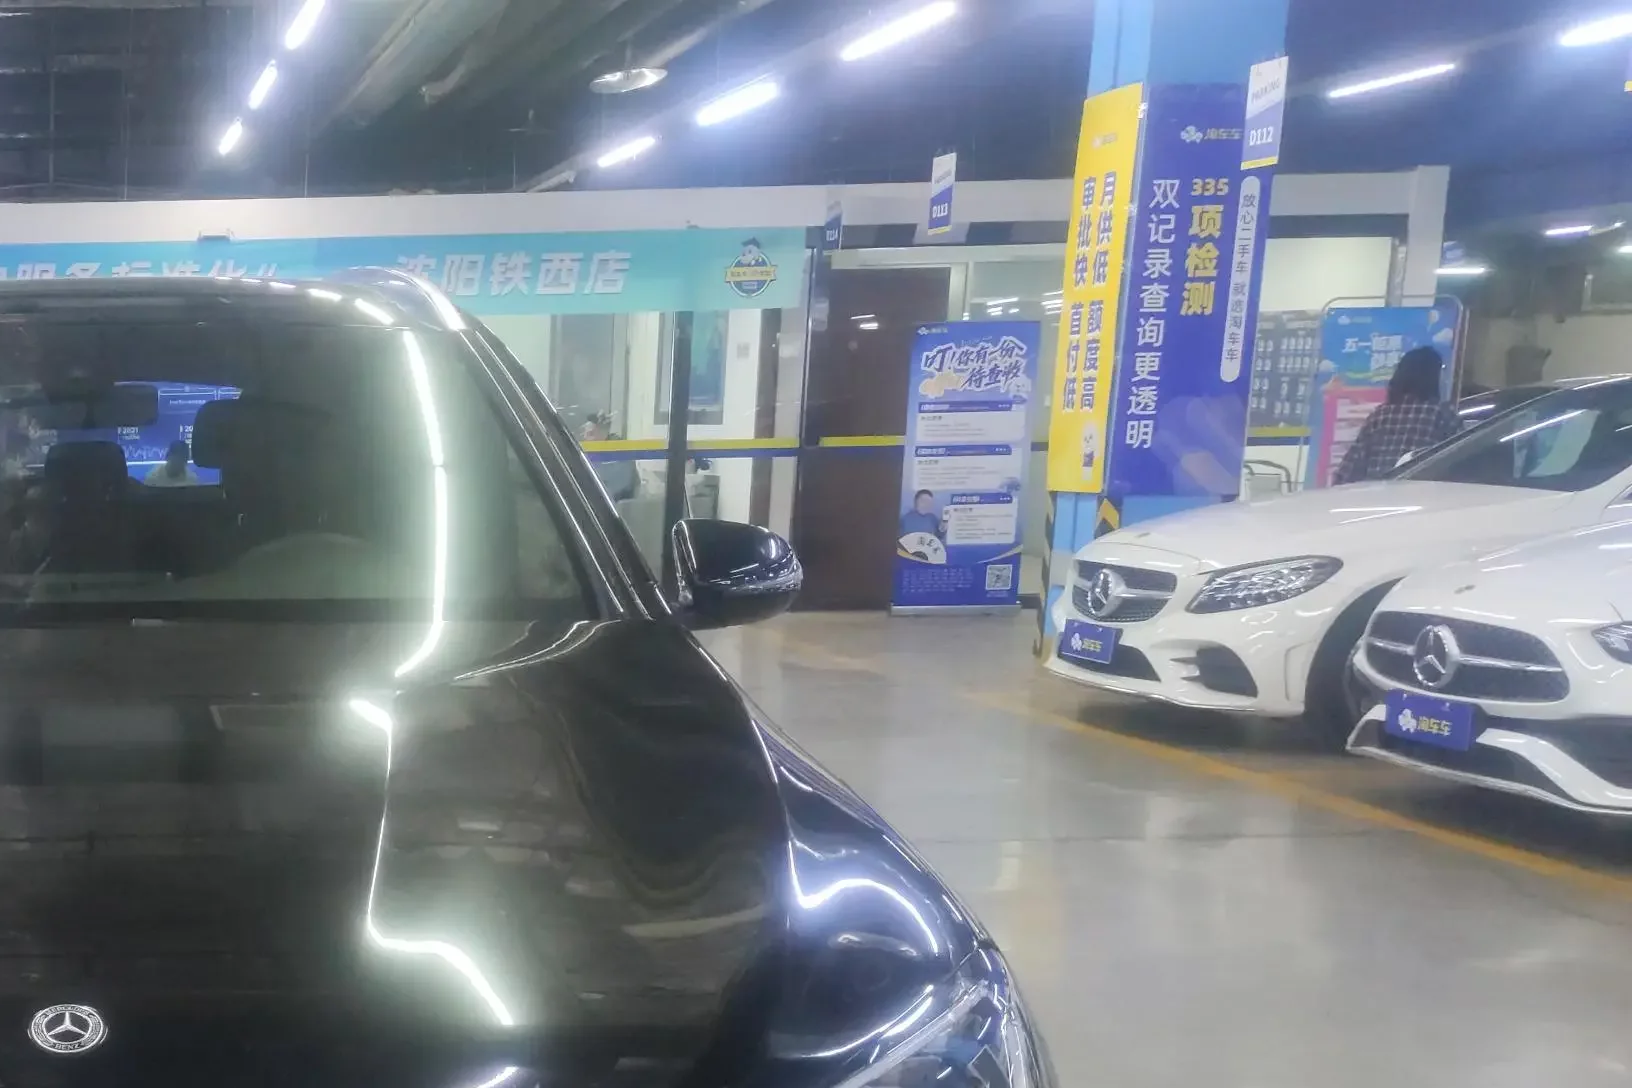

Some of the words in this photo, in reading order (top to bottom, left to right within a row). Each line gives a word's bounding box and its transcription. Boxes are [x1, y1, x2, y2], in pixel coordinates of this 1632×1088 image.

[1249, 126, 1274, 146] D112
[1234, 193, 1256, 274] 放心二手车
[1124, 178, 1181, 449] 双记录查询更透明
